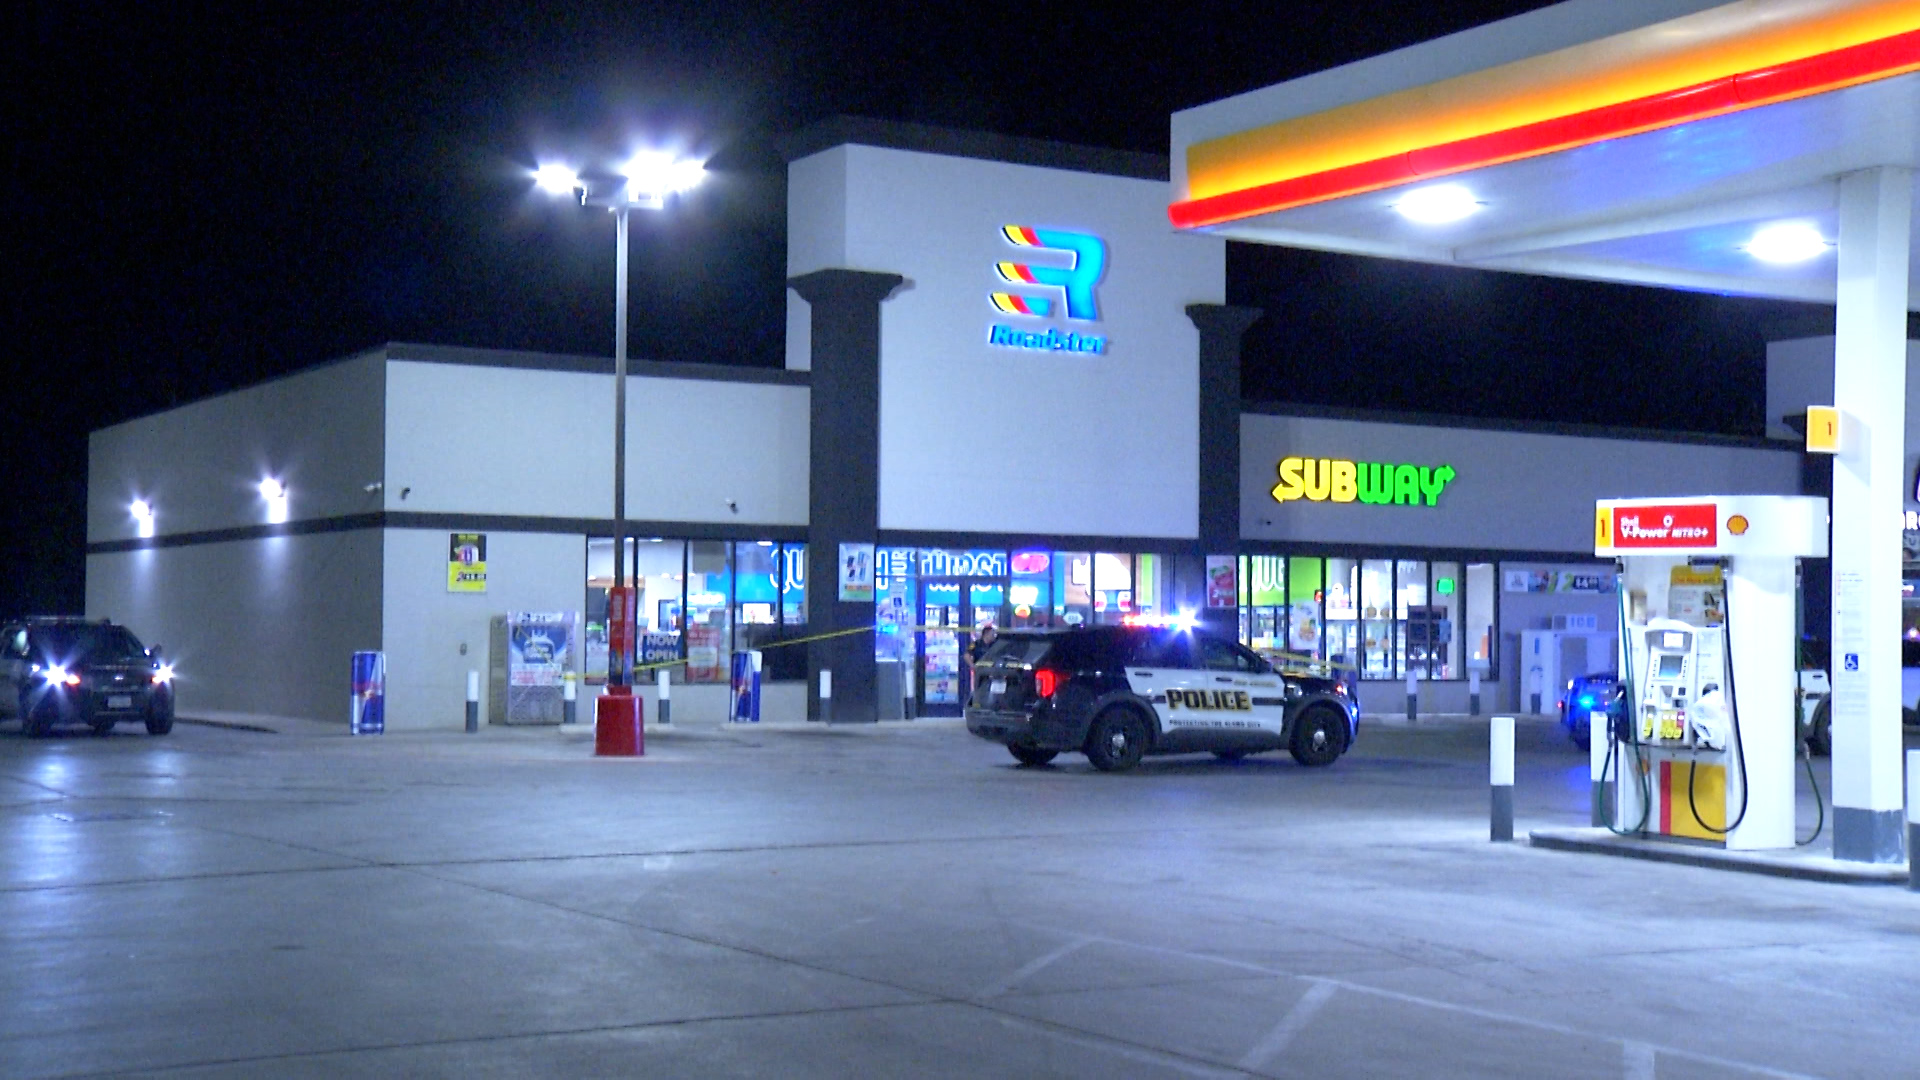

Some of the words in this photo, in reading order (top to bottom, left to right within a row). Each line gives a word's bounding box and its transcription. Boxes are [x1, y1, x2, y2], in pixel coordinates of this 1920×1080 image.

[989, 324, 1107, 355] Roadster
[1271, 457, 1456, 506] SUBWAY
[1620, 515, 1639, 528] Shell
[1620, 526, 1668, 538] V-Power
[647, 634, 680, 645] NOW
[646, 649, 679, 660] OPEN
[1165, 688, 1252, 711] POLICE
